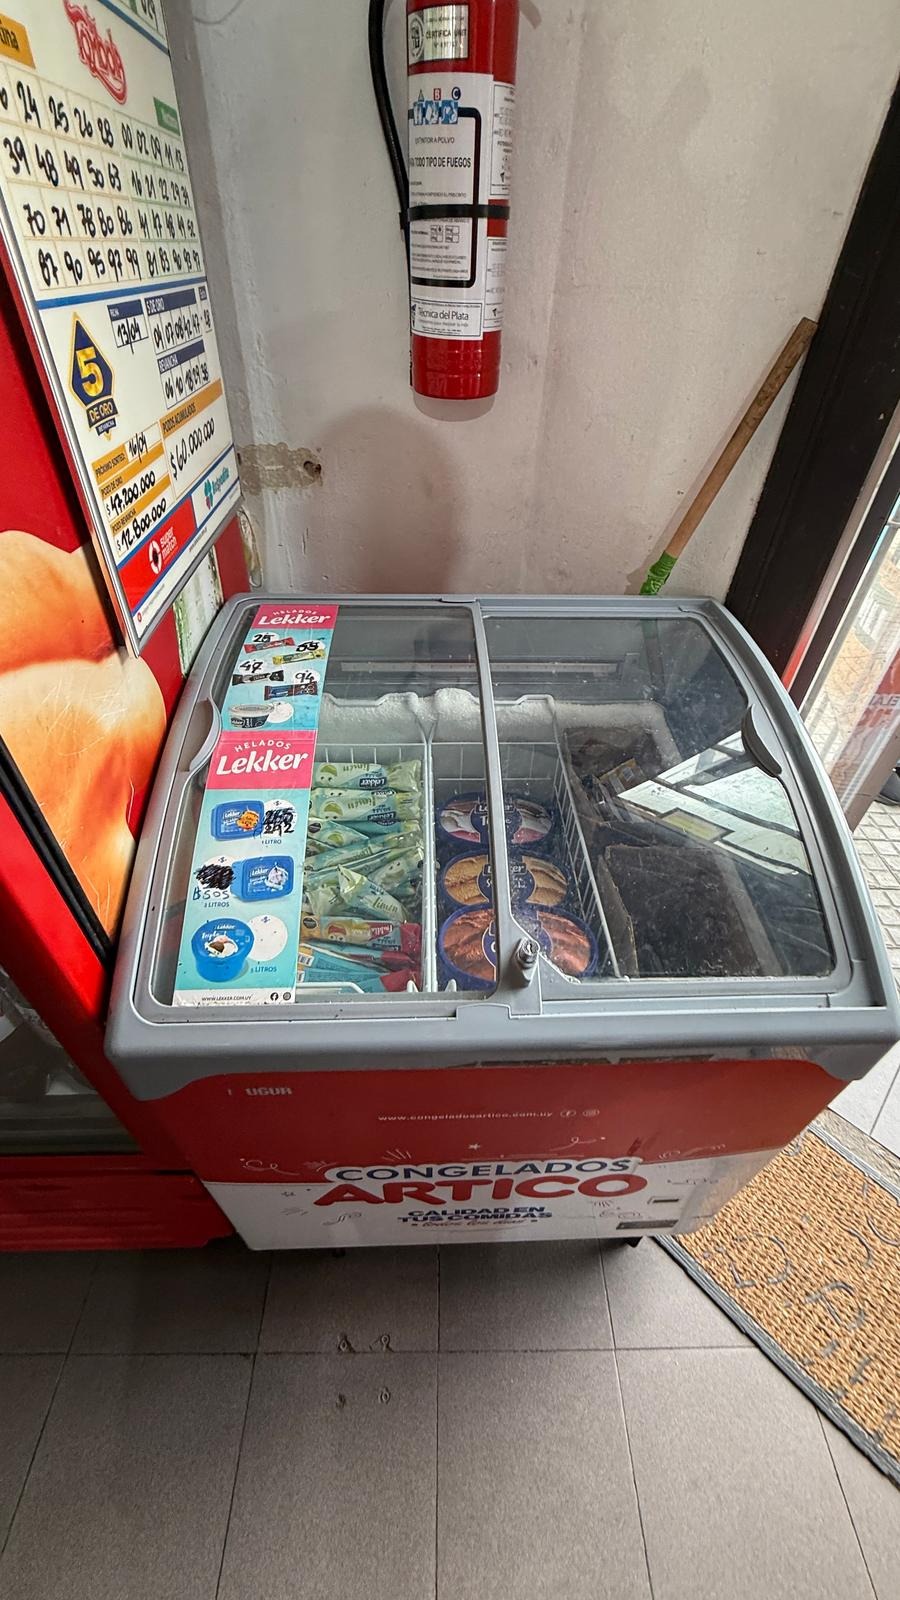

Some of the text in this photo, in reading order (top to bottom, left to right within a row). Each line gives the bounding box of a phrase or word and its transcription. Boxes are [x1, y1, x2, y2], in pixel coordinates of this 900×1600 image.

[434, 88, 441, 100] B
[452, 87, 461, 100] C
[16, 80, 41, 129] 24
[48, 96, 69, 133] 25
[74, 107, 93, 138] 26
[97, 117, 114, 148] 28
[121, 122, 184, 172] 00 02 09 11 13
[438, 136, 455, 144] POLVO
[3, 136, 121, 192] 39 48 49 50 63
[426, 157, 437, 167] TIPO
[438, 157, 446, 167] DE
[447, 157, 471, 168] FUEGOS
[131, 170, 142, 196] 16
[145, 174, 156, 199] 21
[158, 178, 169, 201] 22
[171, 181, 181, 205] 29
[23, 203, 133, 238] 70 71 78 80 86
[138, 208, 150, 239] 41
[152, 209, 162, 238] 47
[165, 211, 175, 239] 48
[187, 219, 196, 237] 52
[38, 248, 142, 287] 87 90 95 97 99
[146, 246, 201, 277] 81 83 90 93 97
[155, 297, 165, 310] ORO
[418, 306, 469, 320] Técnica del Plata
[117, 318, 142, 354] 13/04
[153, 324, 164, 350] 04
[165, 322, 175, 345] 07
[174, 316, 184, 339] 08
[183, 315, 192, 339] 42
[192, 313, 200, 333] 47
[76, 346, 104, 397] 5
[159, 353, 178, 372] REVANCHA
[165, 378, 174, 399] 06
[175, 377, 183, 394] 10
[185, 370, 194, 391] 18
[193, 365, 200, 384] 29
[89, 401, 114, 422] DE ORO
[162, 403, 196, 434] POZOS ACUMULADOS
[128, 432, 149, 463] 16/04
[176, 417, 215, 472] 60.000.000
[101, 485, 111, 496] POZO
[111, 481, 116, 489] DE
[112, 508, 136, 533] POZO REVANCHA
[160, 526, 174, 548] super
[161, 537, 178, 559] match
[258, 614, 331, 625] Lekker
[234, 740, 292, 752] HELADOS
[216, 750, 309, 775] Lekker
[360, 777, 385, 787] Lekker
[336, 1159, 631, 1181] CONGELADOS
[314, 1174, 648, 1205] ARTICO
[408, 1207, 509, 1216] CALIDAD
[448, 1212, 553, 1221] COMIDAS
